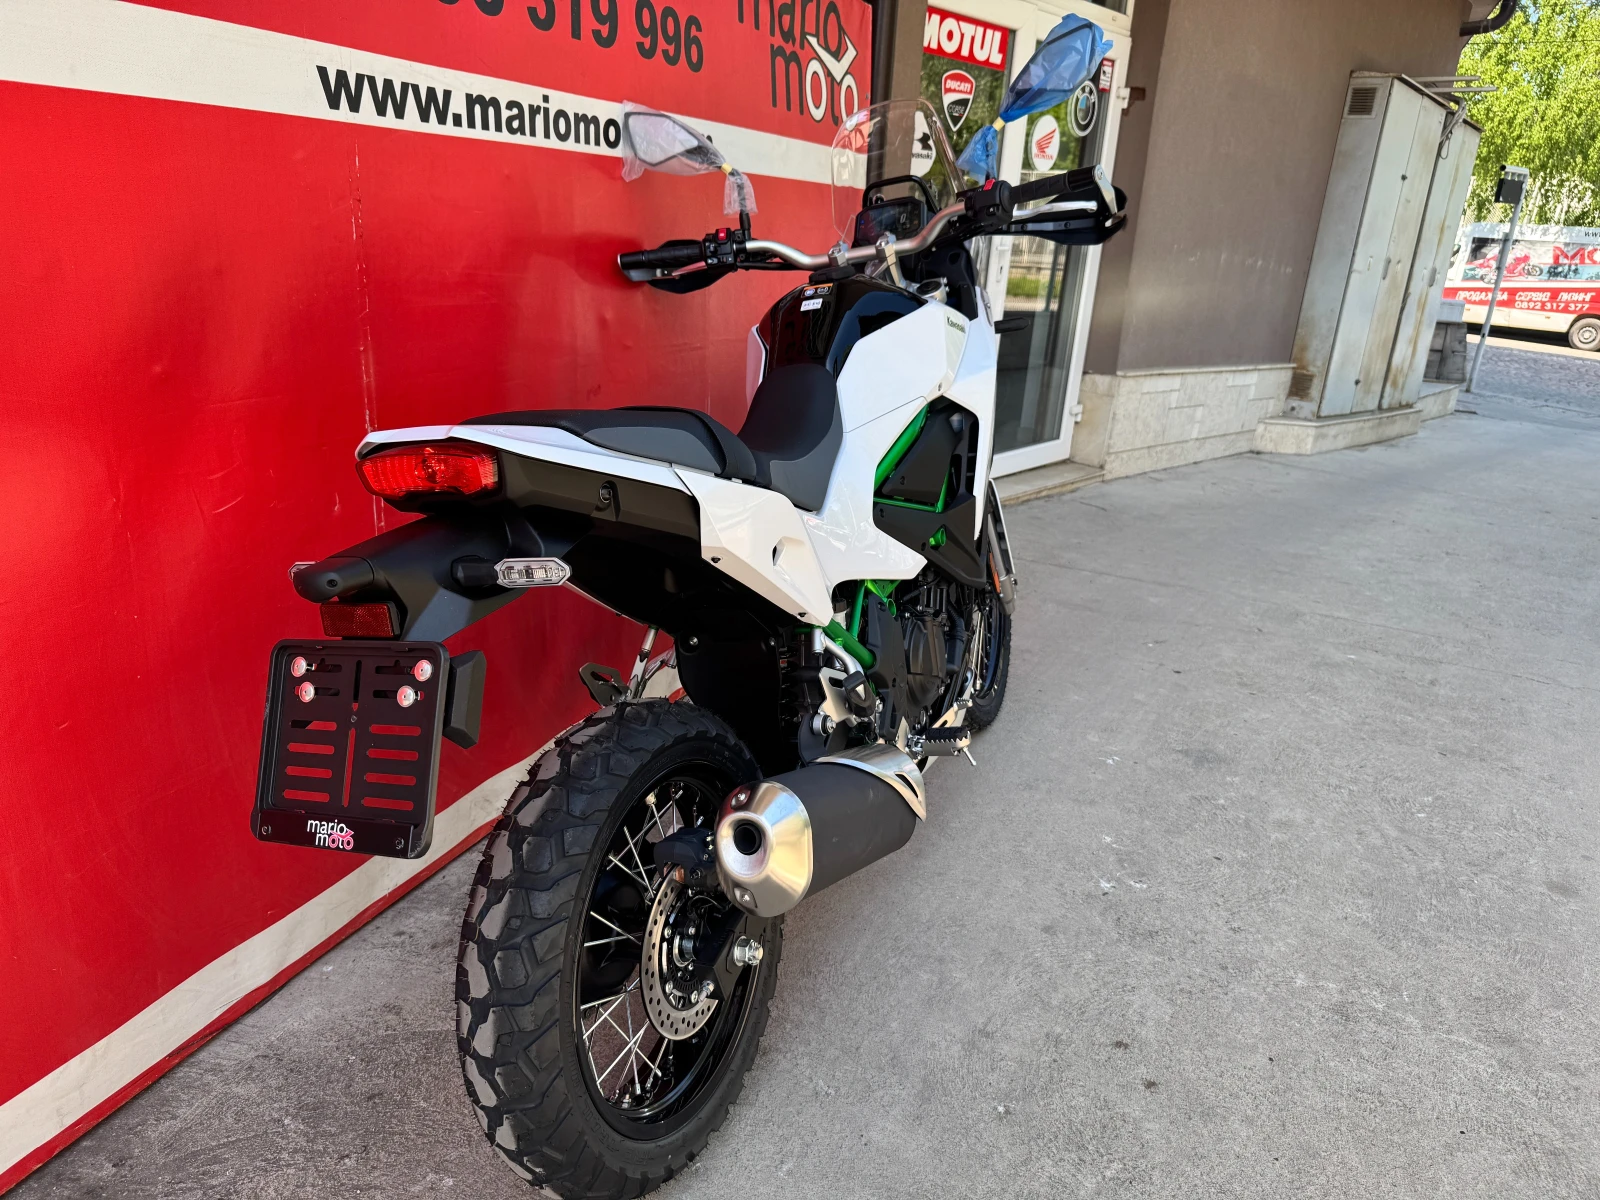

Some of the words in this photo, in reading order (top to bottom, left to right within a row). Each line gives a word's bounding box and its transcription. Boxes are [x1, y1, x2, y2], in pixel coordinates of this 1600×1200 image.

[634, 0, 704, 73] 996
[923, 12, 1004, 65] MOTUL
[769, 43, 859, 131] moto
[945, 79, 972, 92] DUCATI
[948, 103, 965, 115] CORSE
[1034, 153, 1053, 161] HONDA
[1515, 291, 1551, 301] СЕРВИЗ
[1557, 291, 1596, 302] ЛИЗИНГ
[1515, 301, 1541, 309] 0892
[1544, 302, 1565, 310] 317
[1568, 303, 1590, 311] 377
[306, 819, 347, 835] mario
[315, 833, 354, 850] moto
